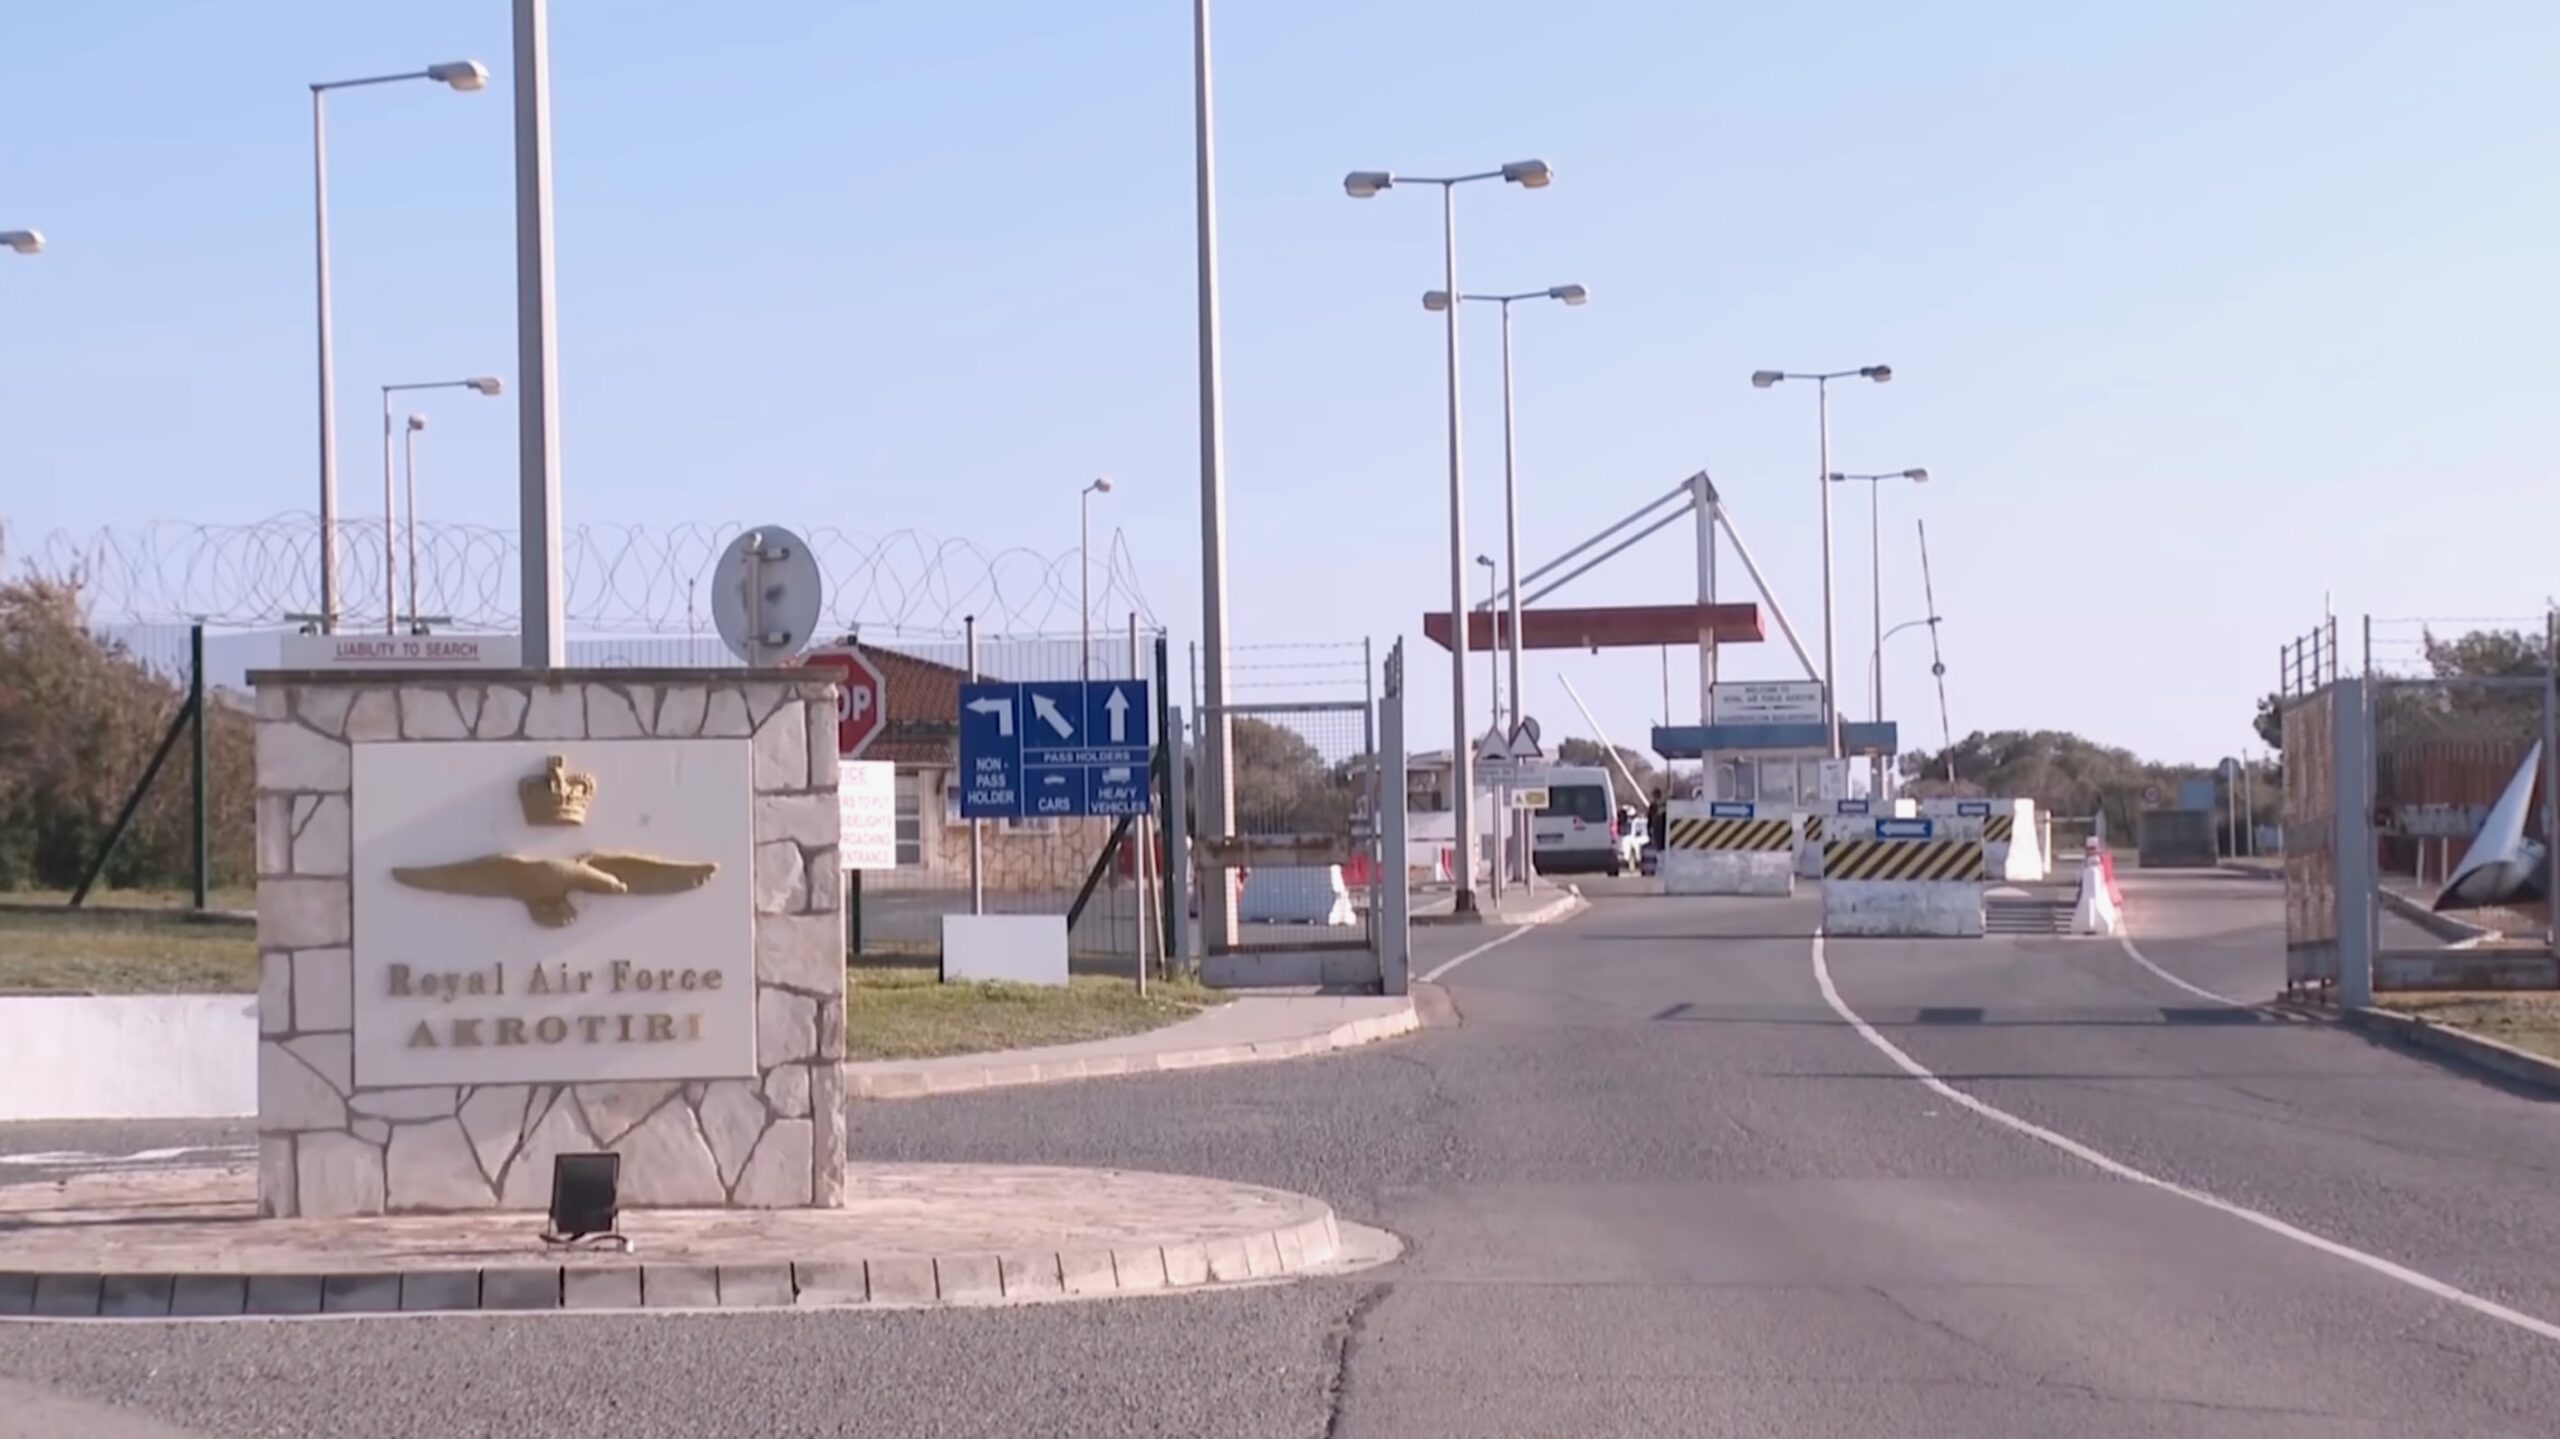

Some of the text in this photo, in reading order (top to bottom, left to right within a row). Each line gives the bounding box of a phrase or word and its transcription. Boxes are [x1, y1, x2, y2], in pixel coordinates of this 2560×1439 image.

[336, 642, 478, 656] LIABILITY TO SEARCH
[838, 684, 872, 721] OP
[1044, 751, 1131, 763] PASS HOLDERS
[976, 774, 1006, 788] PASS
[967, 791, 1015, 805] HOLDER
[1098, 788, 1138, 800] HEAVY
[1038, 798, 1071, 812] CARS
[1091, 801, 1147, 814] VEHICLES
[387, 960, 724, 1003] Royal Air Force
[407, 1013, 704, 1048] AKROTIRI
